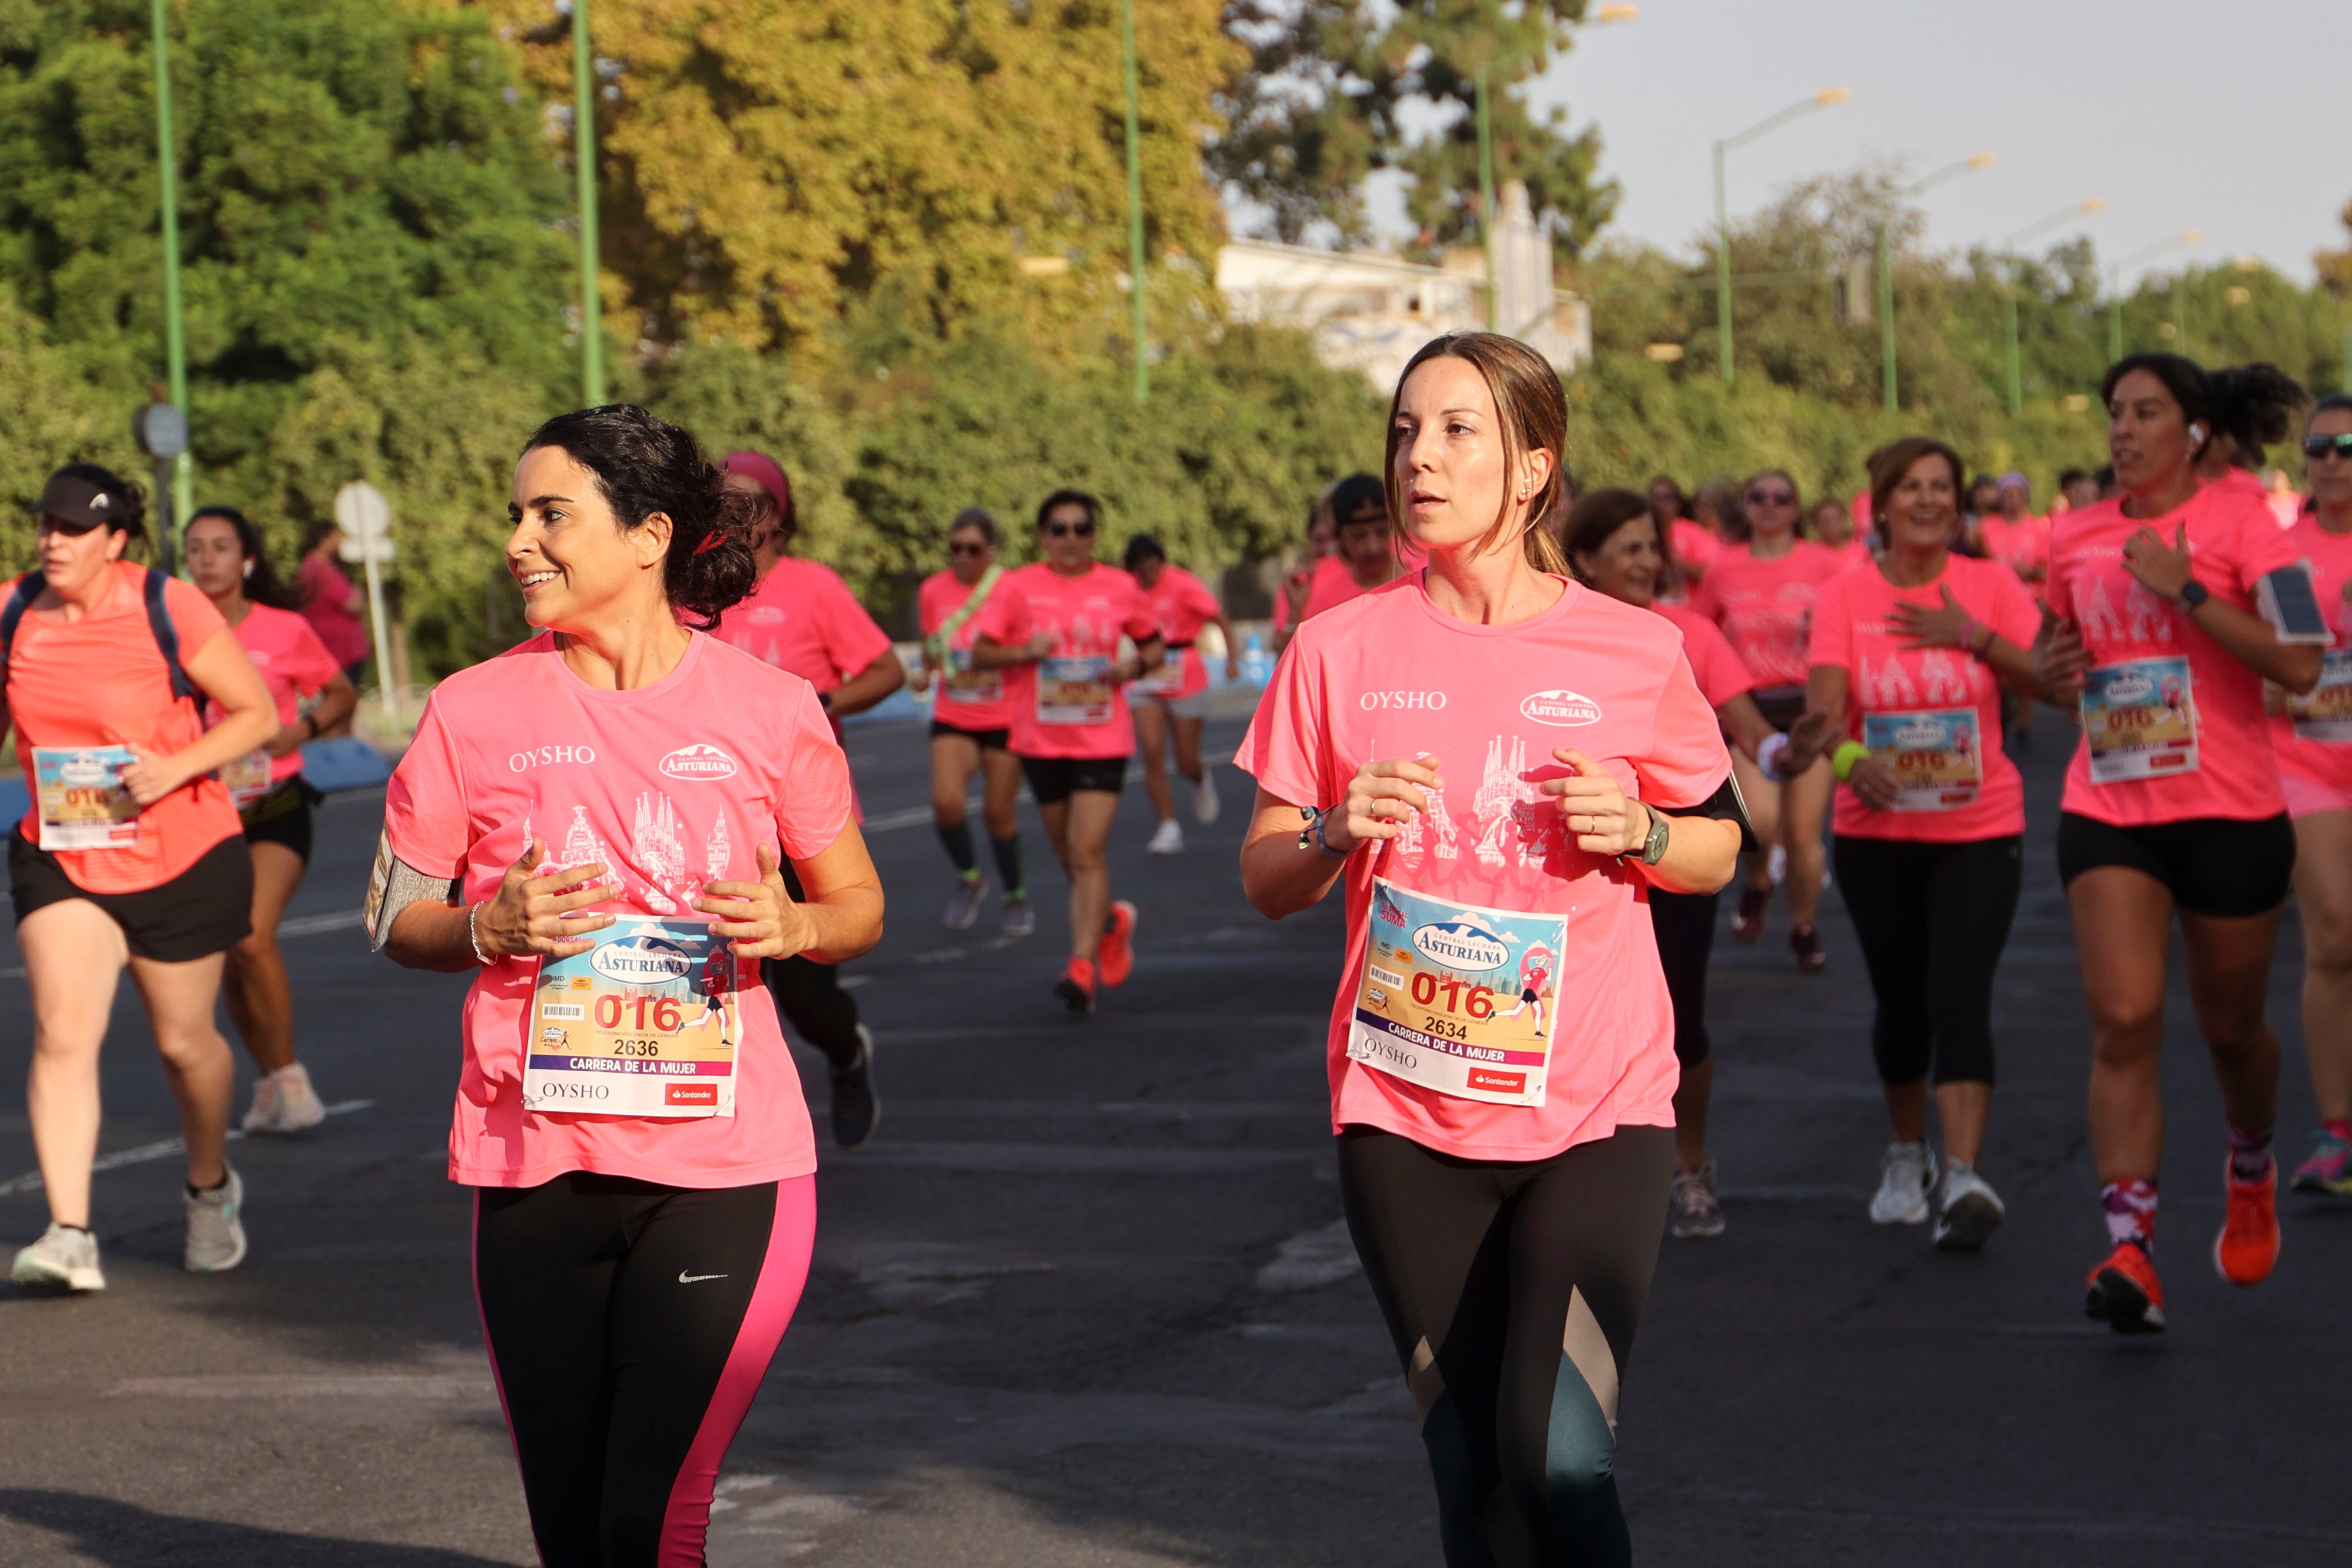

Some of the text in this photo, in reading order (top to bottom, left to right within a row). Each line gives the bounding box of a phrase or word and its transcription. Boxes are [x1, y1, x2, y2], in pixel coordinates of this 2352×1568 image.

[1361, 691, 1447, 710] OYSHO
[1527, 700, 1595, 720] ASTURIANA
[2109, 707, 2153, 732] 016
[509, 746, 595, 772] OYSHO
[665, 758, 732, 773] ASTURIANA
[1897, 750, 1945, 772] 016
[1380, 909, 1406, 929] SUMA
[1418, 931, 1501, 964] ASTURIANA
[1434, 933, 1500, 950] CENTRAL LECHERA
[598, 951, 684, 973] ASTURIANA
[1411, 972, 1495, 1019] 016
[595, 994, 681, 1031] 016
[1425, 1016, 1467, 1040] 2634
[613, 1039, 659, 1057] 2636
[1388, 1022, 1505, 1062] CARRERA DE LA MUJER
[1364, 1038, 1418, 1069] OYSHO
[570, 1058, 696, 1074] CARRERA DE LA MUJER
[542, 1082, 609, 1099] OYSHO
[1484, 1077, 1519, 1087] Santander
[681, 1091, 711, 1099] Santander
